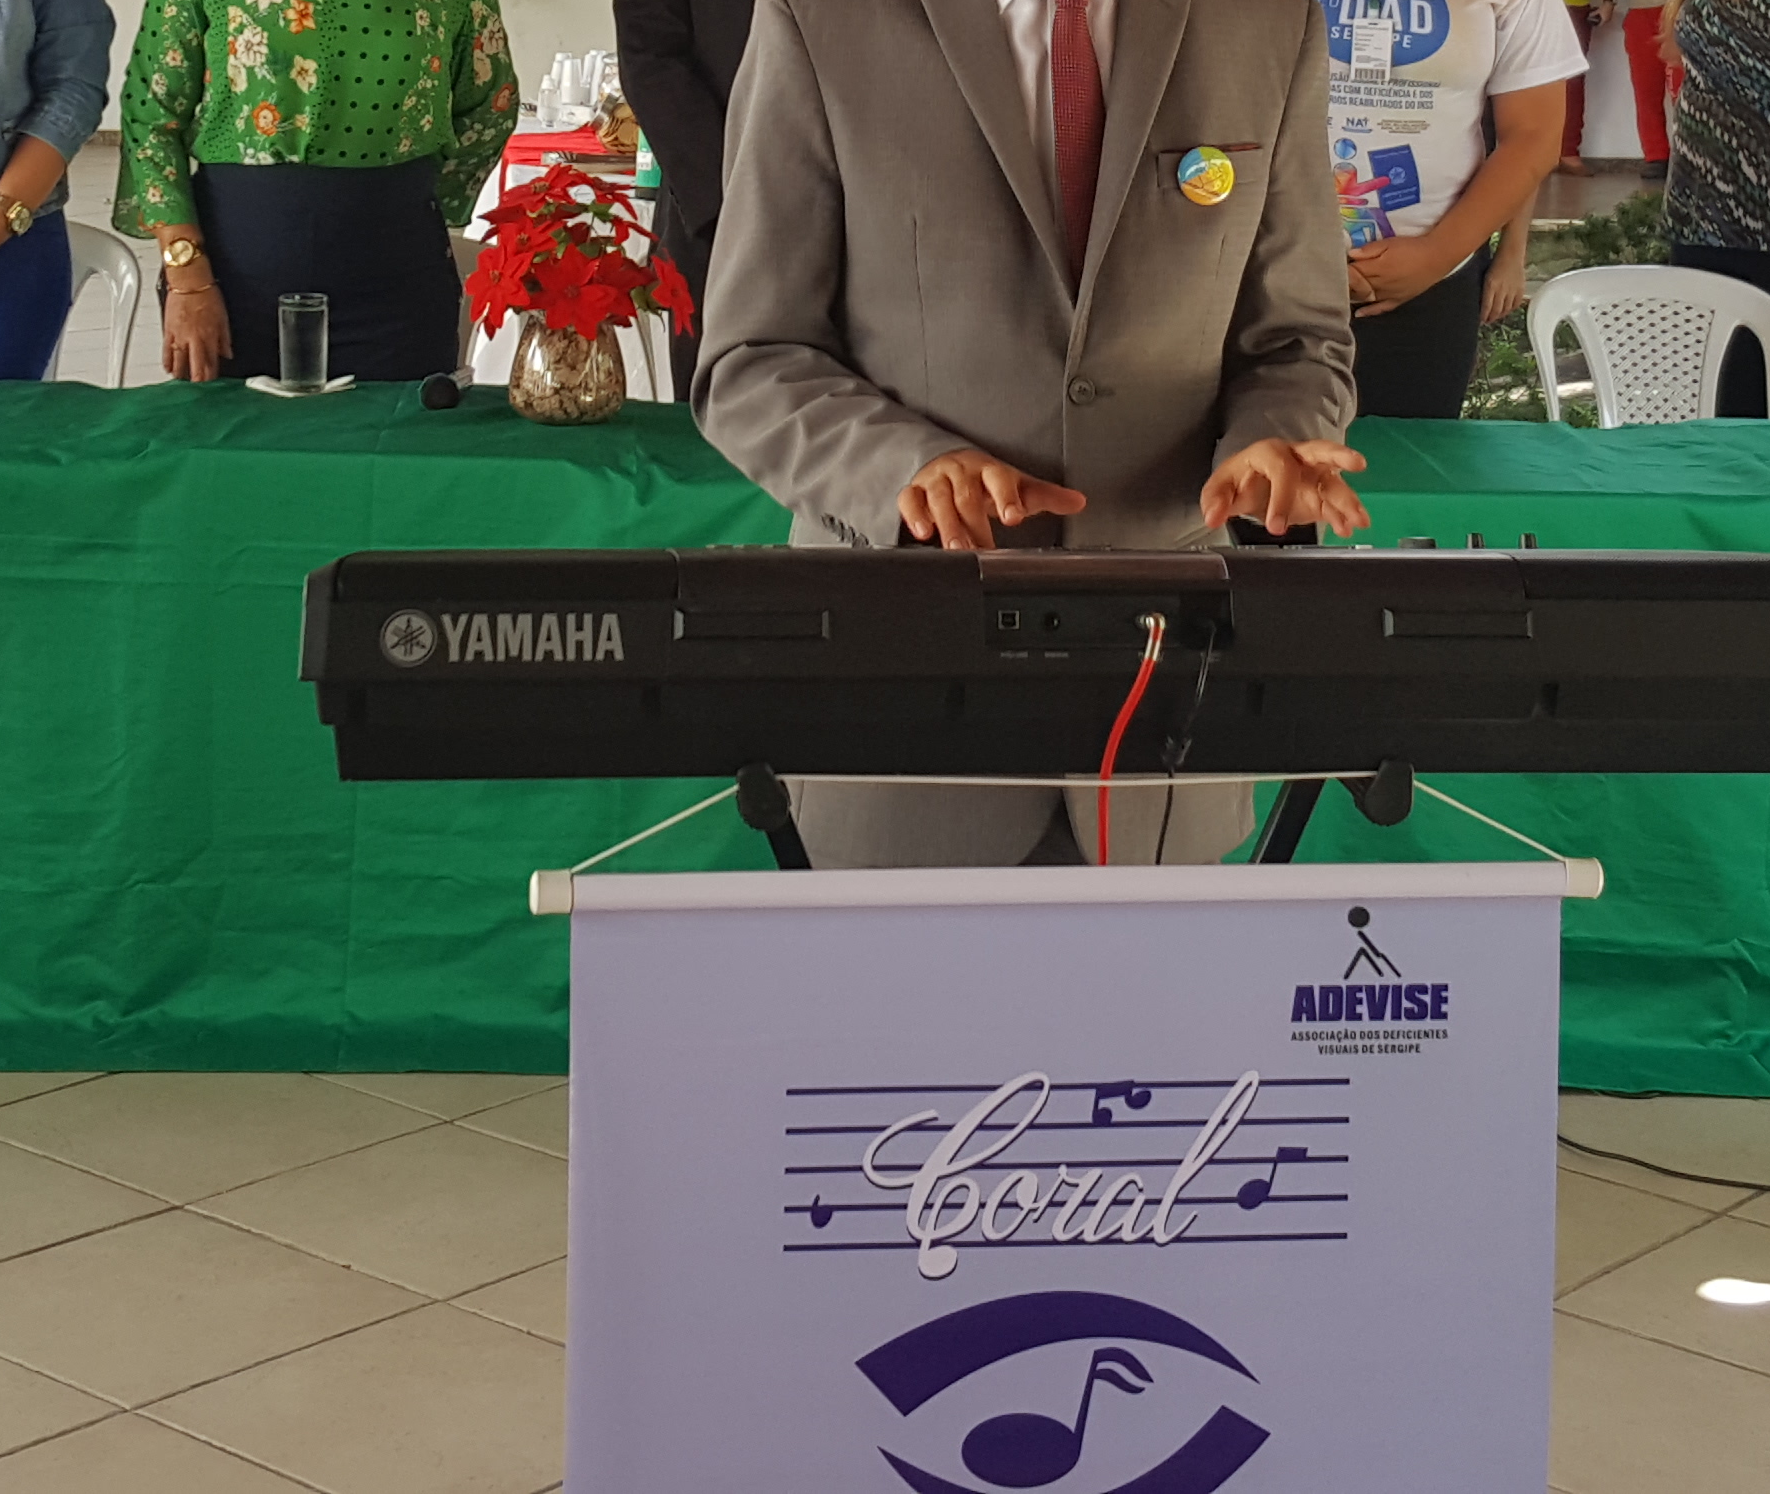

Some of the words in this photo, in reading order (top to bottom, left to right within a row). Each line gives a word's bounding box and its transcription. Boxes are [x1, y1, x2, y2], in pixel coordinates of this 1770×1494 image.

[440, 612, 625, 663] YAMAHA
[1290, 982, 1449, 1023] ADEVISE
[1291, 1028, 1357, 1043] ASSOCIAÇÃO
[1359, 1029, 1381, 1040] DOS
[1383, 1028, 1449, 1040] DEFICIENTES
[1318, 1044, 1359, 1055] VISUAIS
[1361, 1044, 1375, 1054] DE
[1377, 1043, 1422, 1055] SERGIPE
[861, 1067, 1261, 1281] Coral
